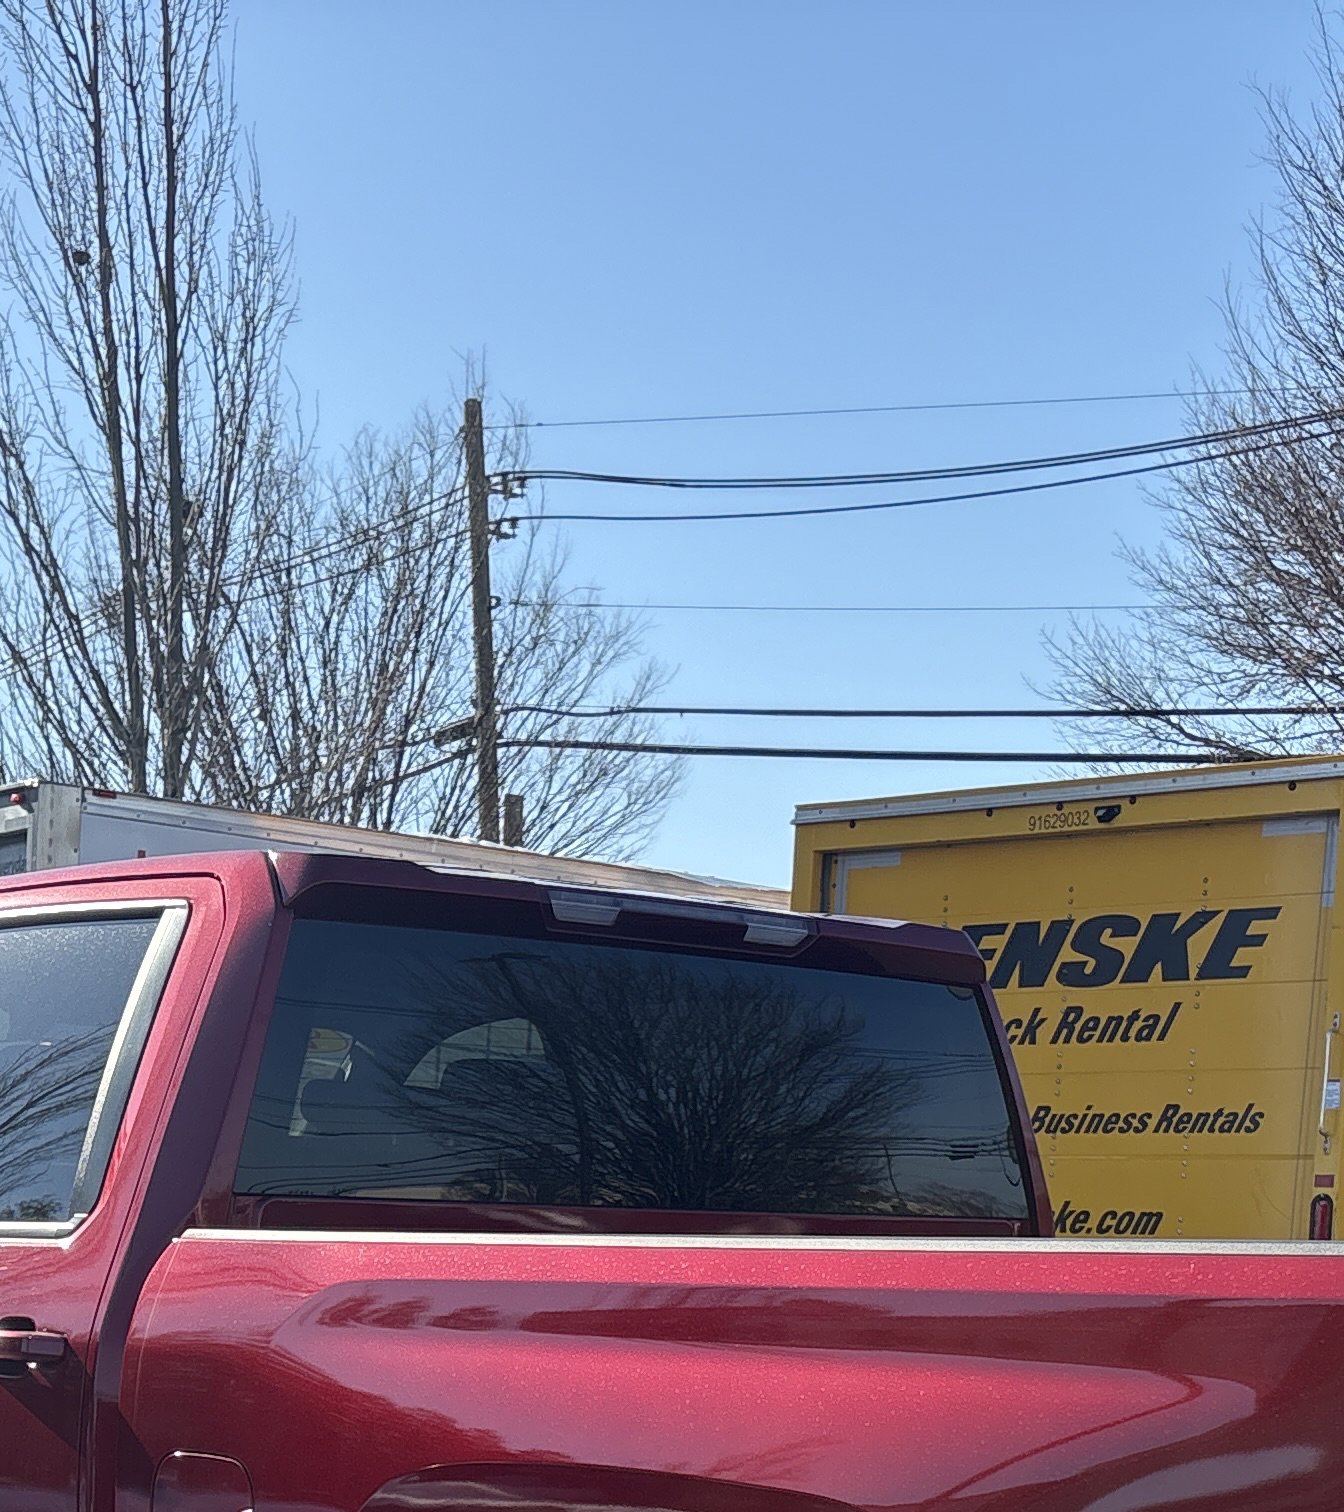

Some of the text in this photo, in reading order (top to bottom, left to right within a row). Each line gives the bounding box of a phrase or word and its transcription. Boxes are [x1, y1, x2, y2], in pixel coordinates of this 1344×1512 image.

[1028, 810, 1090, 831] 91629032
[961, 906, 1283, 989] ENSKE
[1005, 1001, 1183, 1045] ck Rental
[1032, 1102, 1265, 1135] Business Rentals
[1054, 1200, 1164, 1235] ke.com
